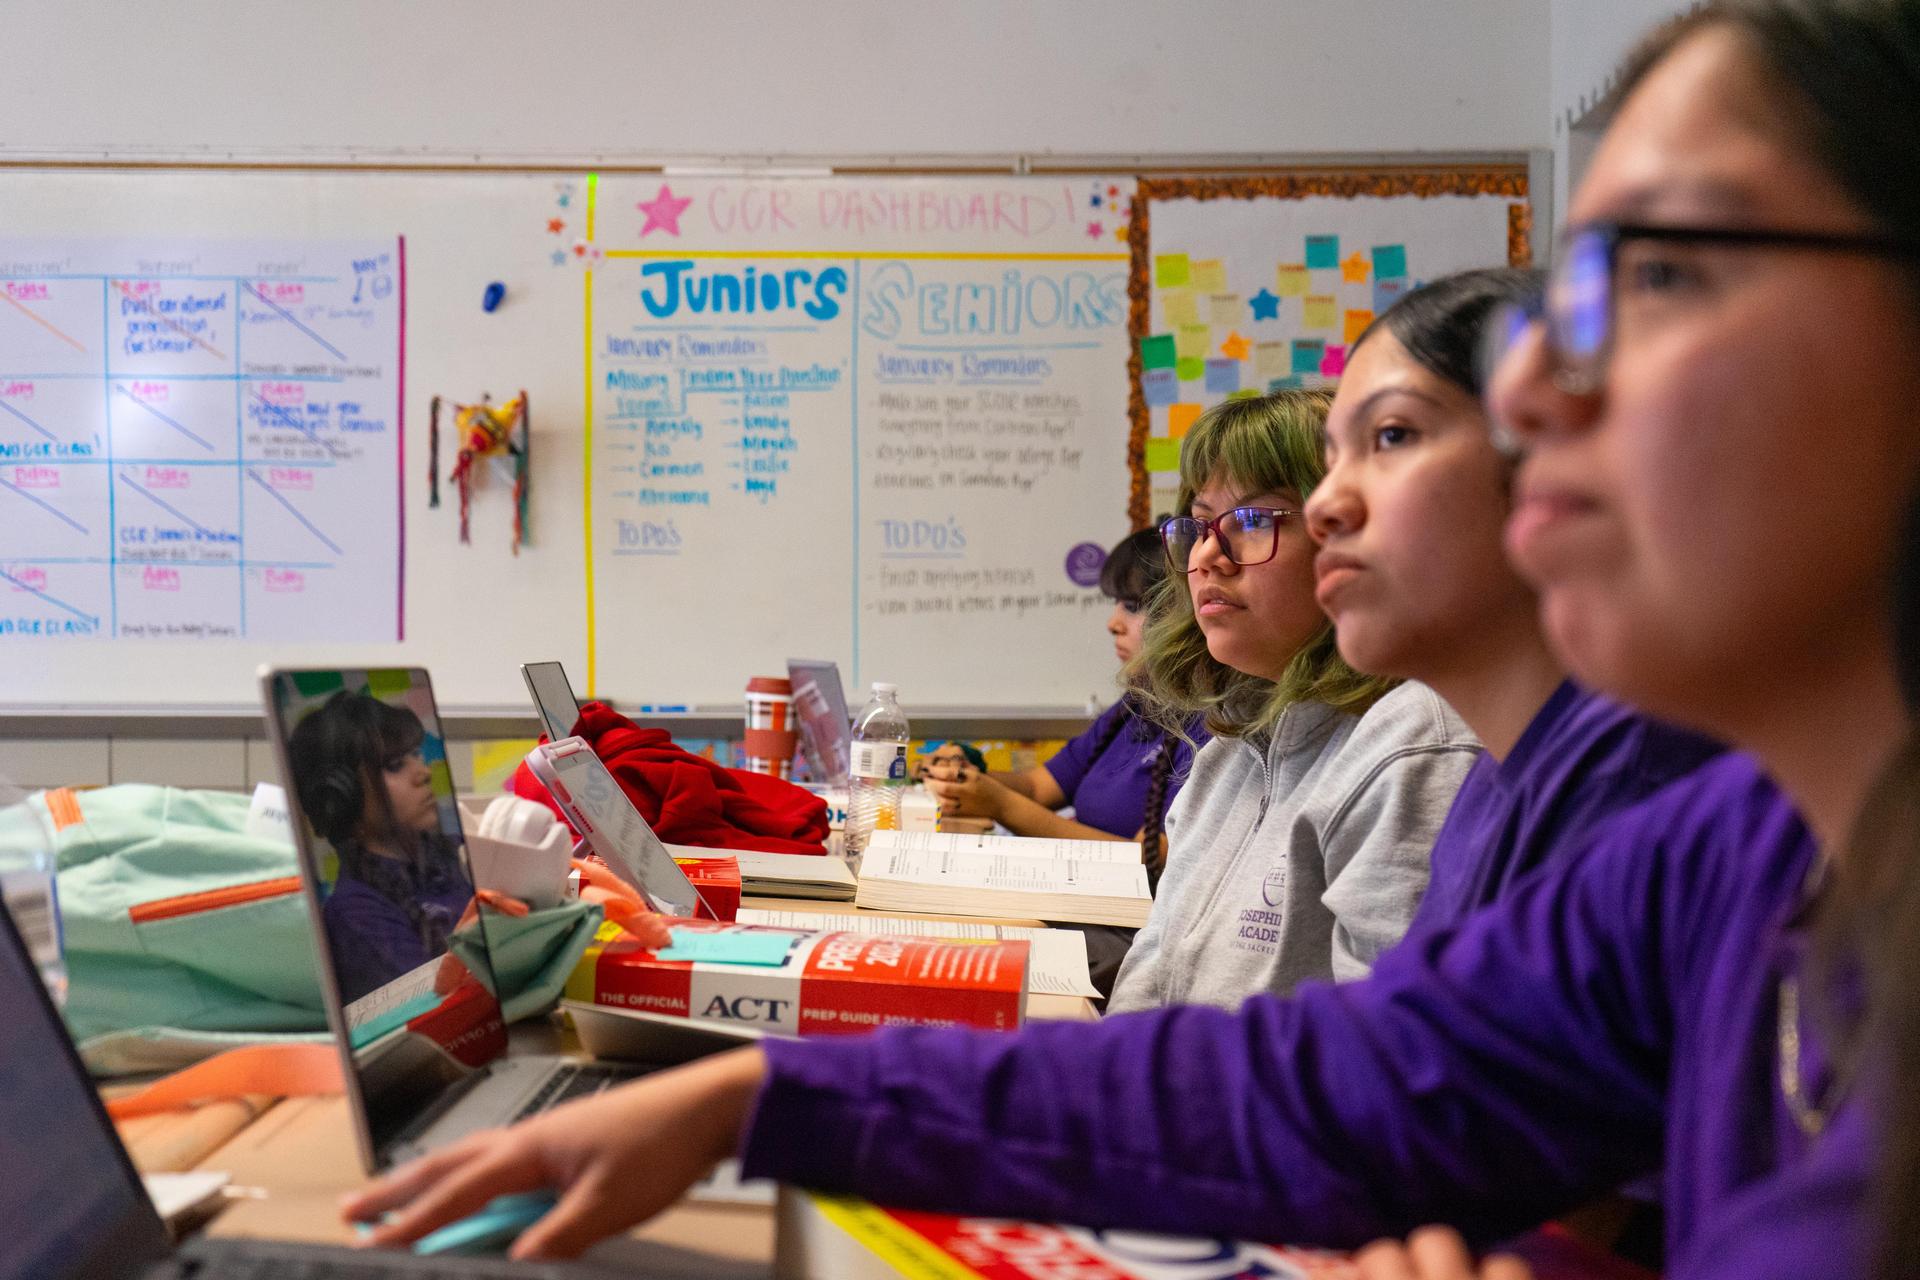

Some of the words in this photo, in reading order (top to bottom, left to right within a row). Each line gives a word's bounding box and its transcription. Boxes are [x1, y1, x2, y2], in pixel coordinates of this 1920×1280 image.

[817, 180, 1075, 238] DASHBOARD!
[640, 260, 848, 321] Juniors
[1239, 909, 1282, 926] OSEPHI
[1238, 925, 1280, 943] ACADE
[601, 991, 626, 1004] THE
[628, 993, 688, 1010] OFFICIAL
[701, 994, 789, 1023] ACT
[803, 1007, 837, 1022] PREP
[839, 1010, 881, 1026] GUIDE
